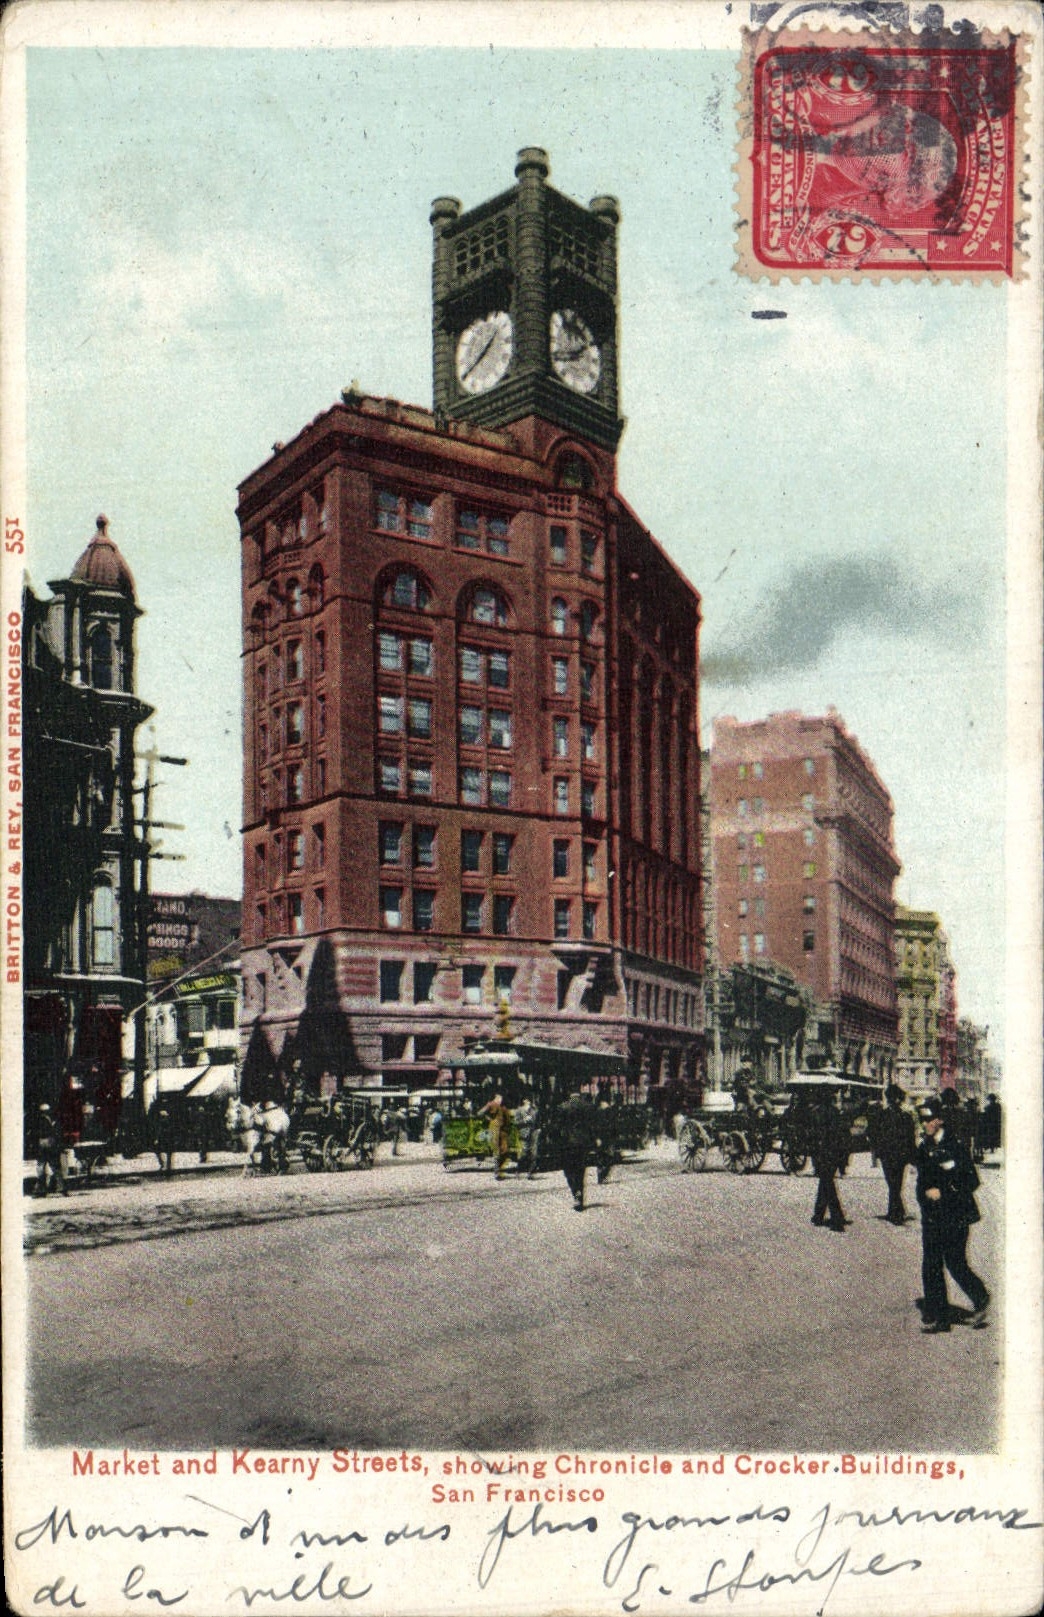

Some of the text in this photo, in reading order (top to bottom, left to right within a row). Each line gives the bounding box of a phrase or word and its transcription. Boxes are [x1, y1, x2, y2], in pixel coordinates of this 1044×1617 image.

[767, 144, 784, 252] CENTS
[782, 88, 796, 228] POTAGE
[796, 113, 815, 201] WAINGTON
[959, 117, 992, 233] AMERICA
[826, 225, 866, 254] 2
[962, 163, 1005, 258] STATES
[33, 1576, 86, 1608] de
[124, 1564, 189, 1606] la
